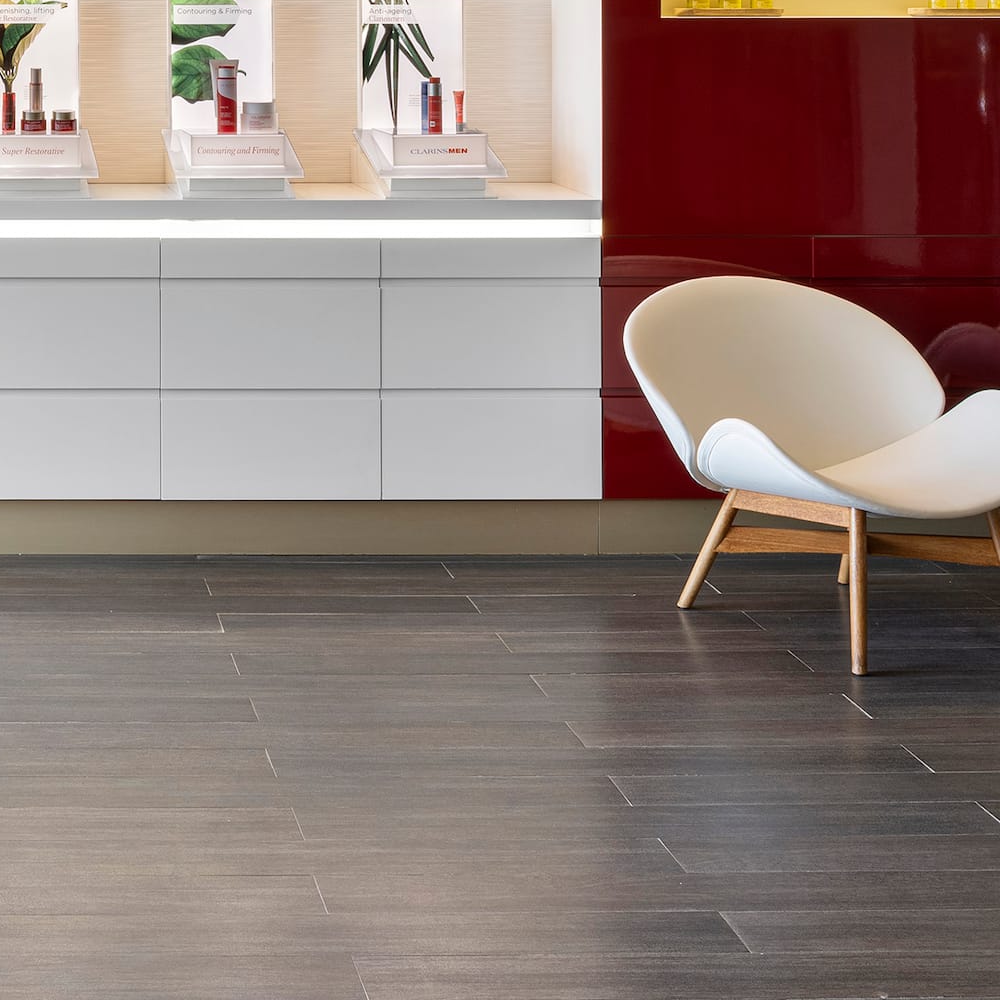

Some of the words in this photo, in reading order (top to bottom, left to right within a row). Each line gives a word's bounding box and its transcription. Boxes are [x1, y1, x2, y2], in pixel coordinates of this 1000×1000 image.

[33, 7, 55, 16] lifting
[177, 7, 217, 16] Contouring
[225, 7, 253, 16] Firming
[369, 8, 412, 16] Anti-ageing
[1, 147, 23, 156] Super
[25, 147, 65, 155] Restorative
[197, 146, 236, 156] Contouring
[236, 146, 251, 155] and
[251, 146, 280, 156] Firming
